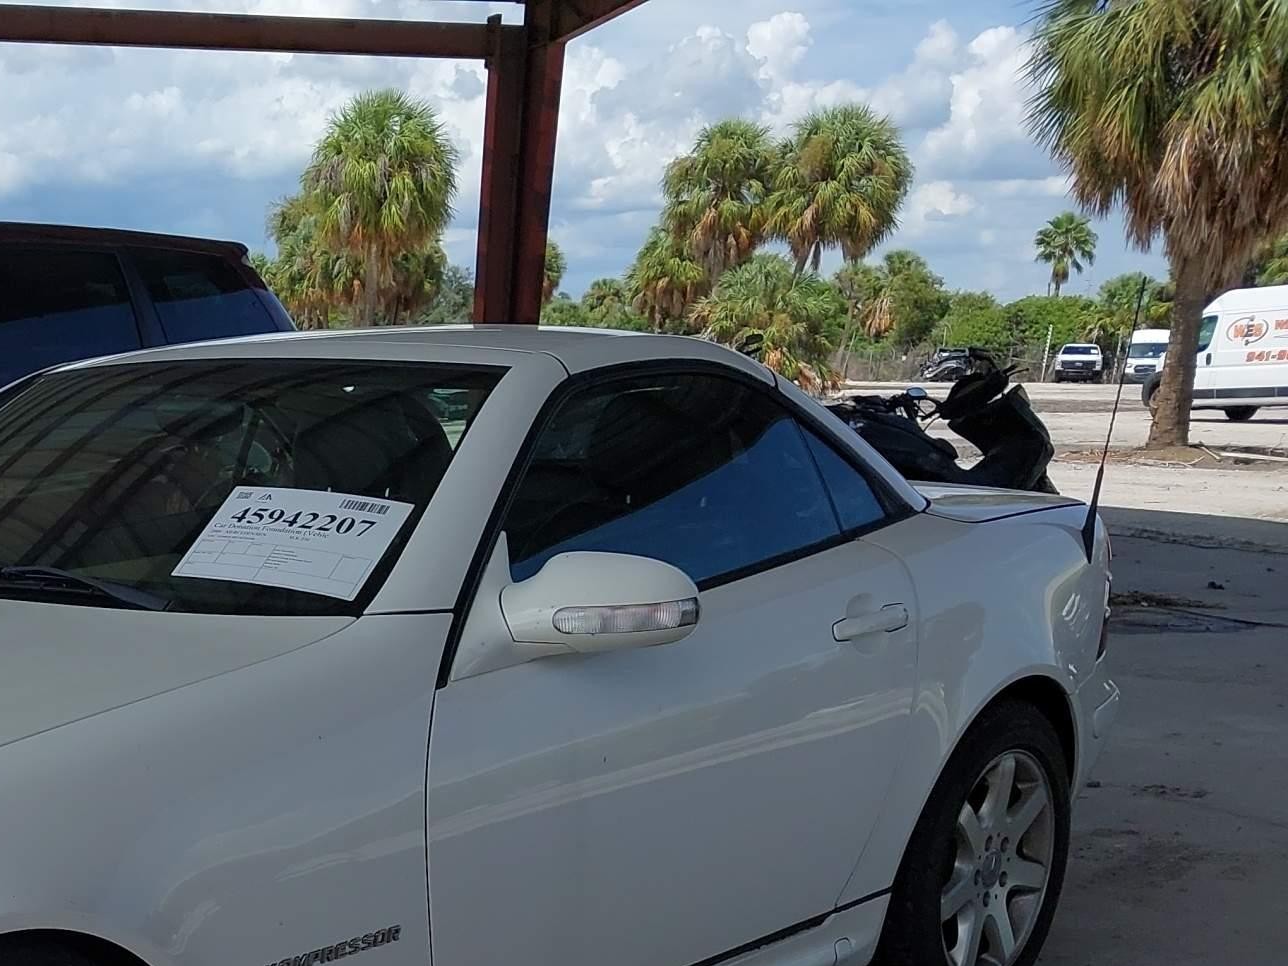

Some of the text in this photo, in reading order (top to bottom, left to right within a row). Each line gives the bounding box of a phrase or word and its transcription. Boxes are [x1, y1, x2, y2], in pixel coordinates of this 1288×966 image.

[228, 522, 261, 531] Donation
[262, 525, 302, 535] Foundation
[230, 506, 377, 538] 45942207
